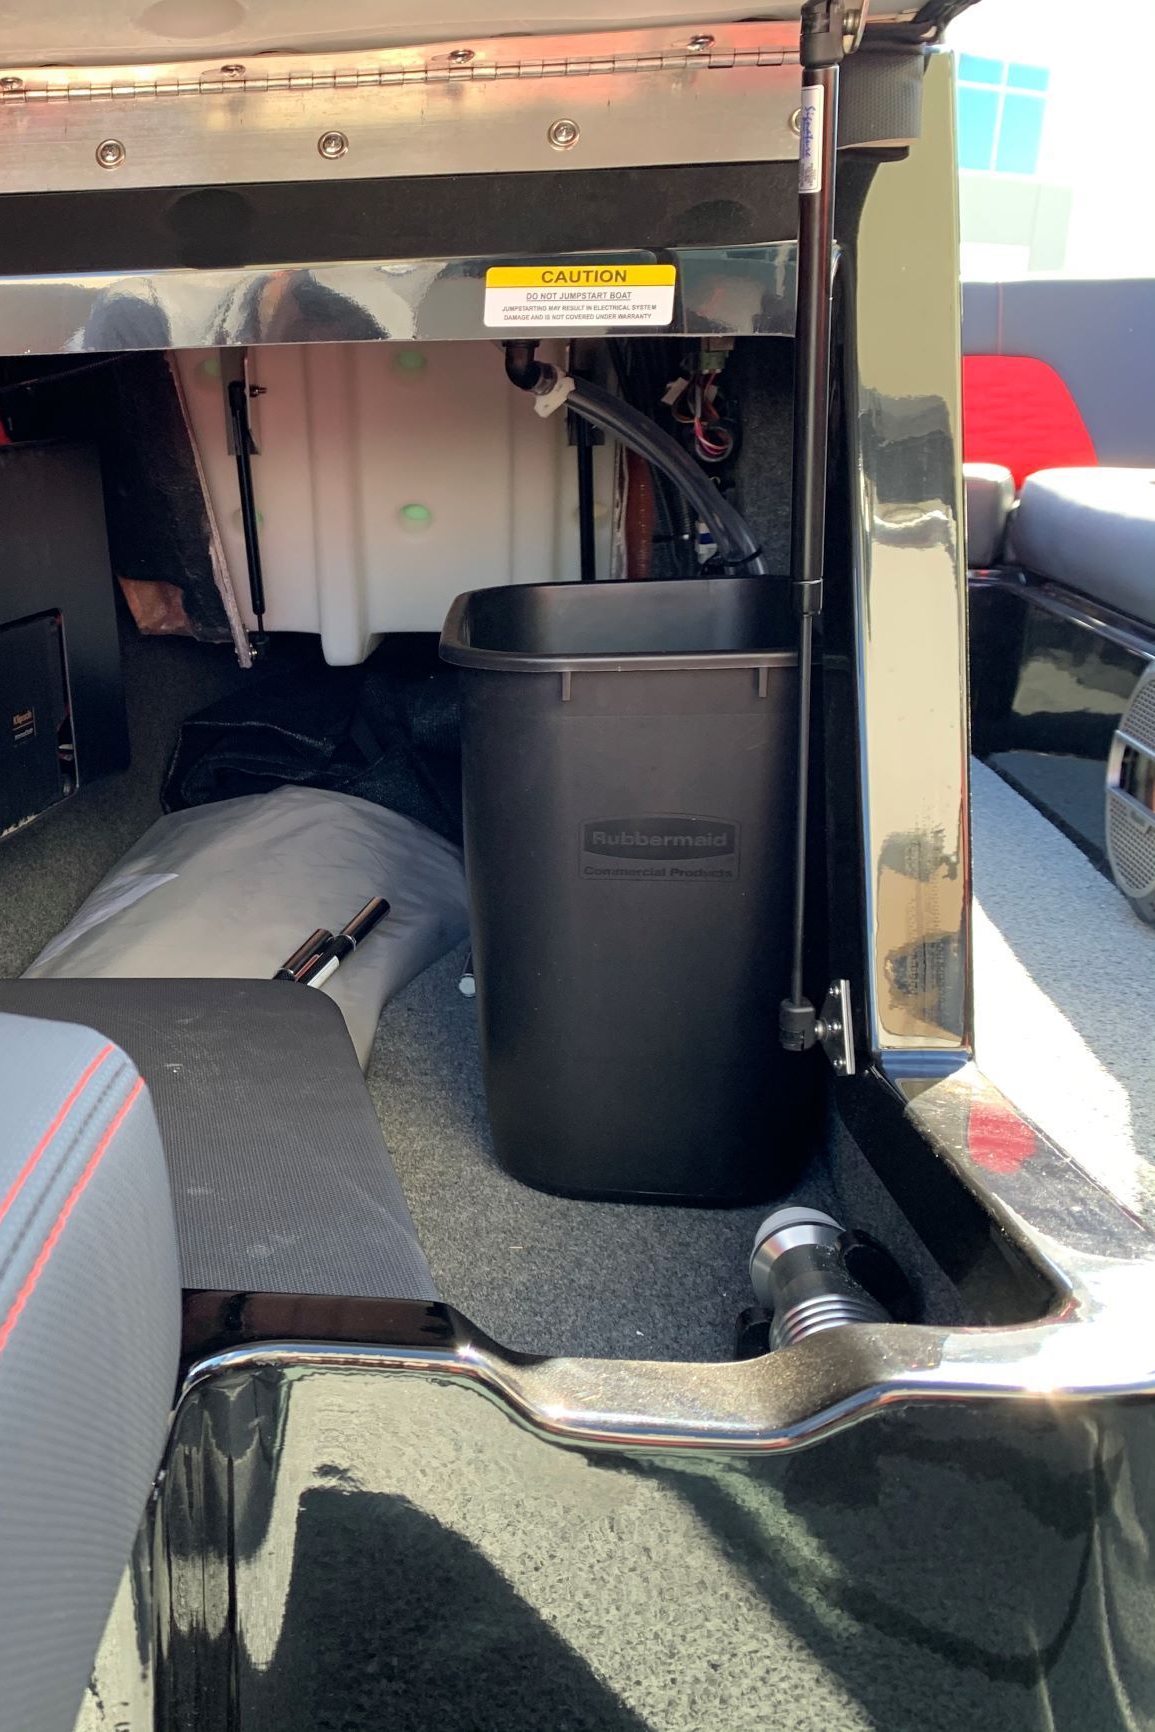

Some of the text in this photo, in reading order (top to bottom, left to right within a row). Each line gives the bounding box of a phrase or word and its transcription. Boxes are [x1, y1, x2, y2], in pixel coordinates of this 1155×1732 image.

[541, 269, 627, 284] CAUTION
[526, 291, 633, 300] DO NOT JUMPSTART BOAT
[591, 831, 727, 847] Rubbermaid
[584, 866, 734, 878] Commercial Products
